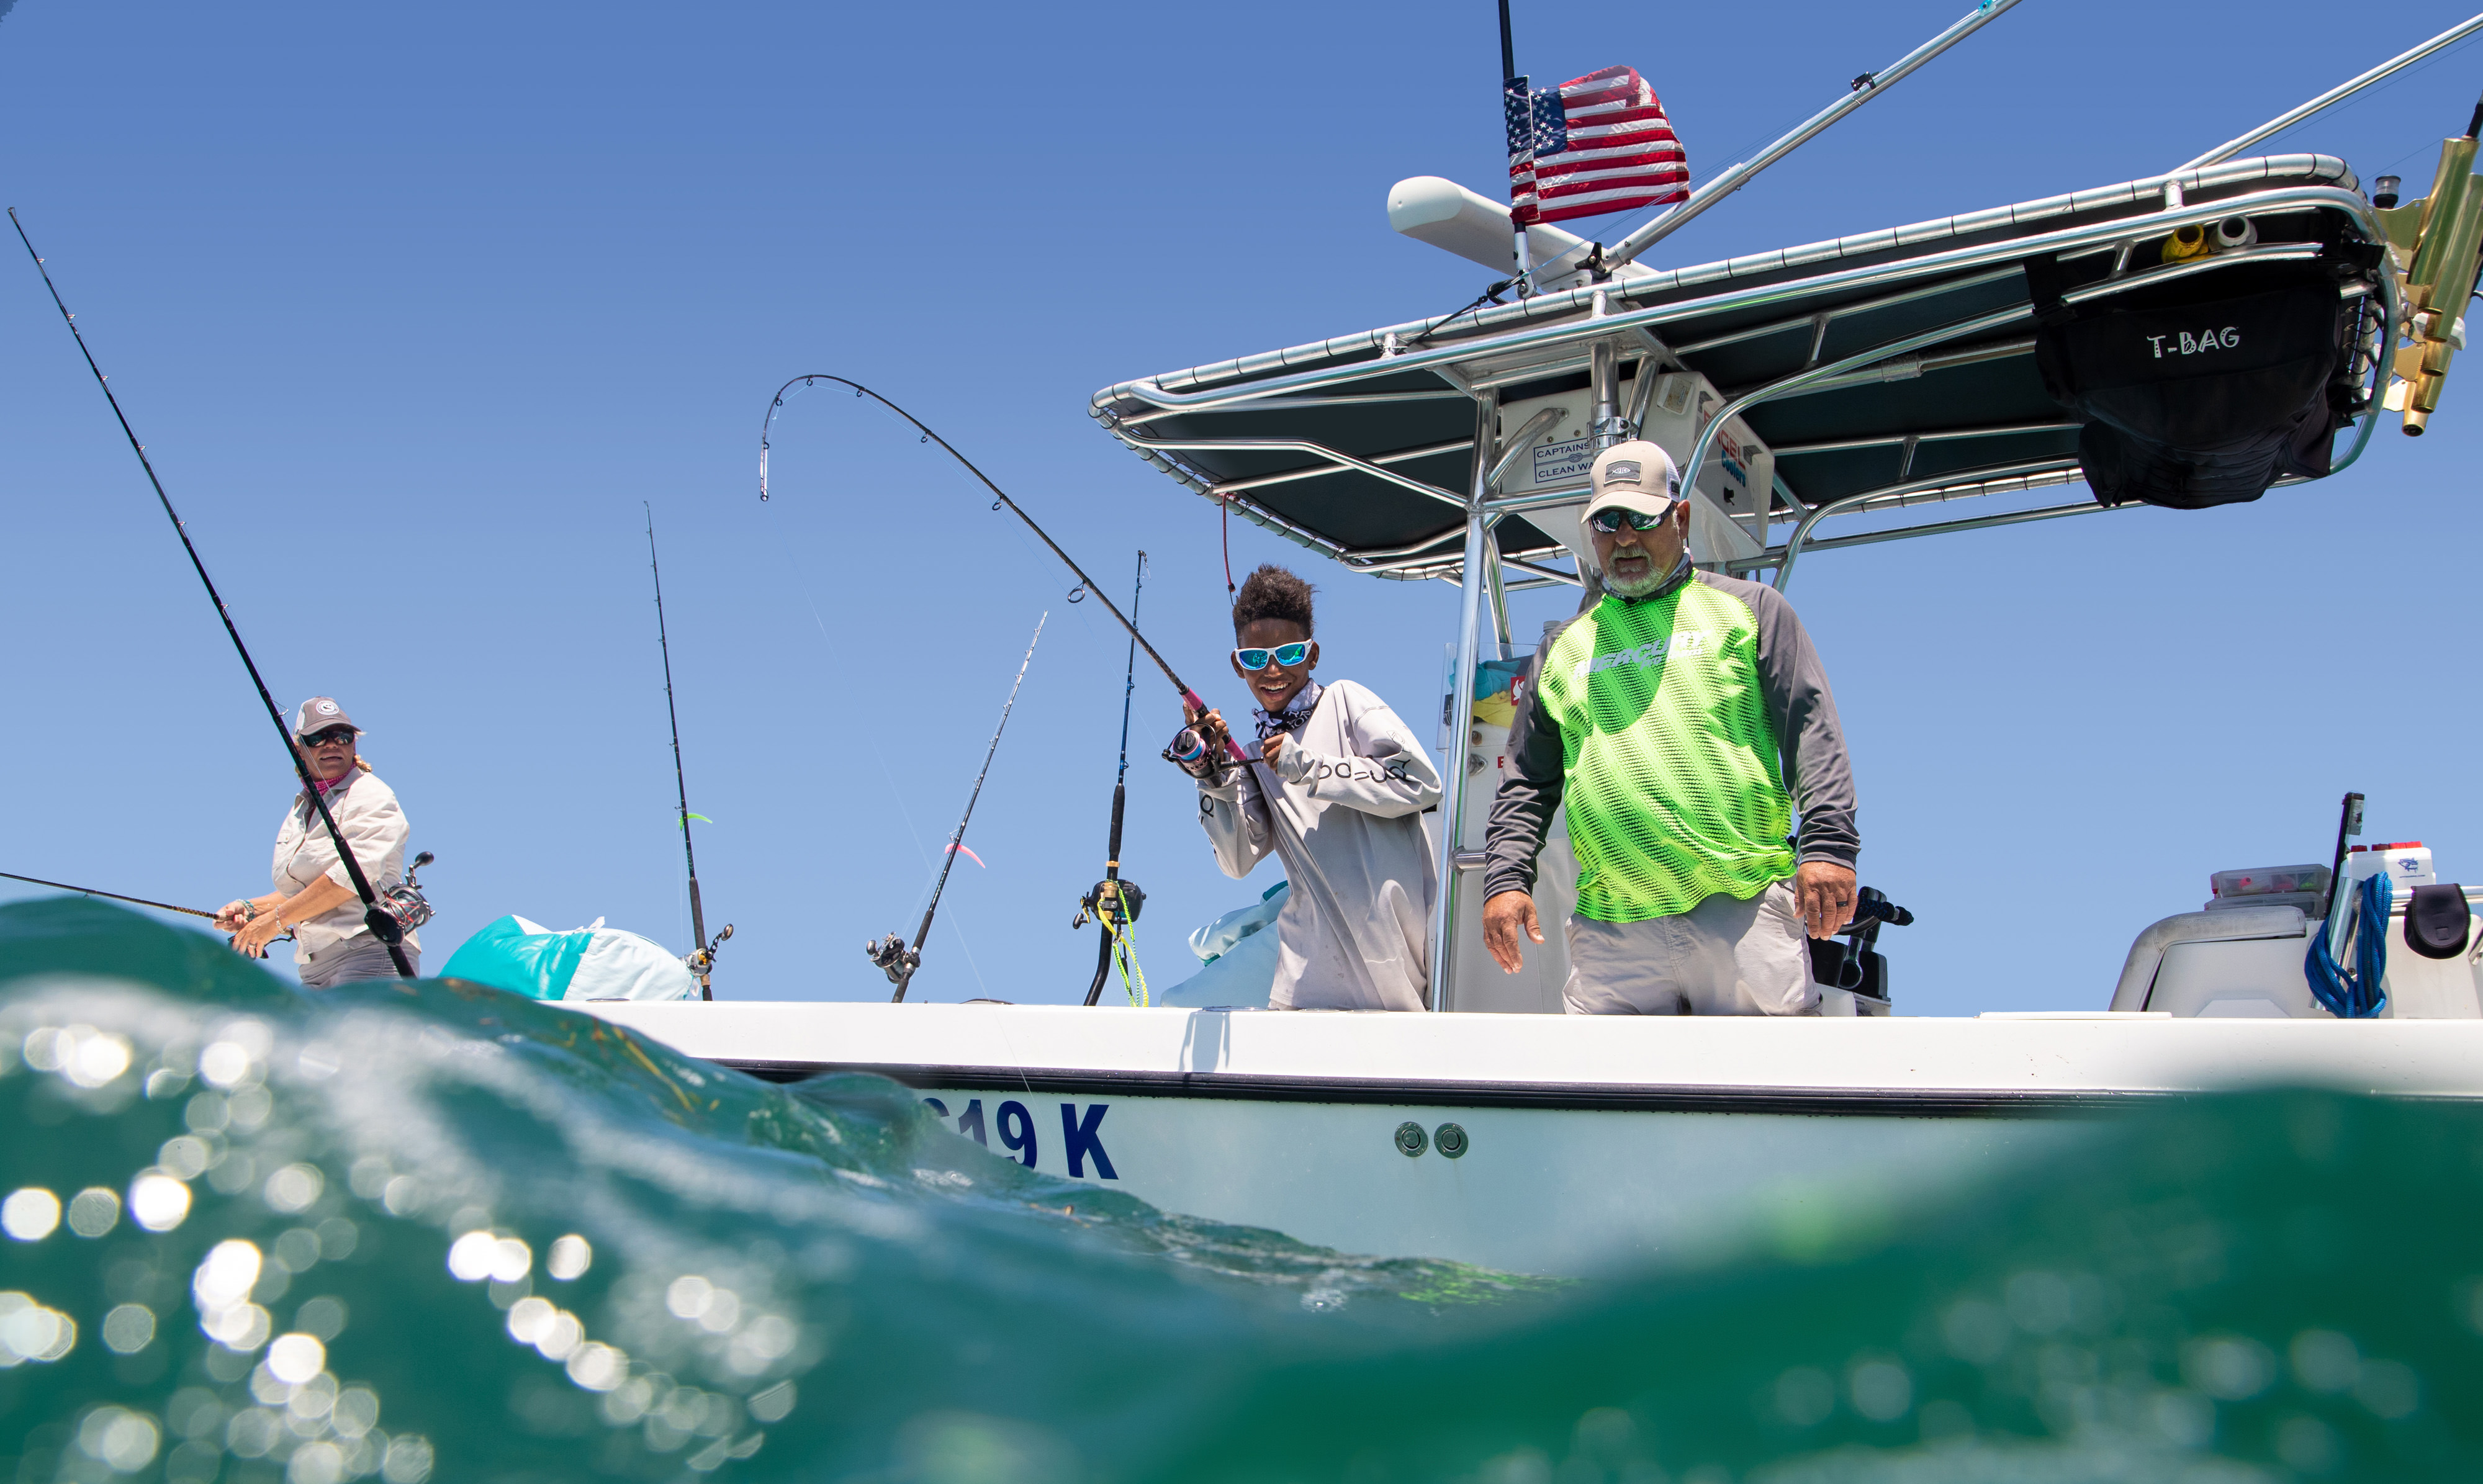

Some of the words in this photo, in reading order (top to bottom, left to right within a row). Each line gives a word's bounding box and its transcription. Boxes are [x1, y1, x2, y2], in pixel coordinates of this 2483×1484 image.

[2147, 326, 2240, 358] T-BAG
[1536, 442, 1589, 458] CAPTAINS
[1538, 465, 1575, 478] CLEAN
[1721, 449, 1746, 488] Coolers
[1060, 1103, 1119, 1180] K
